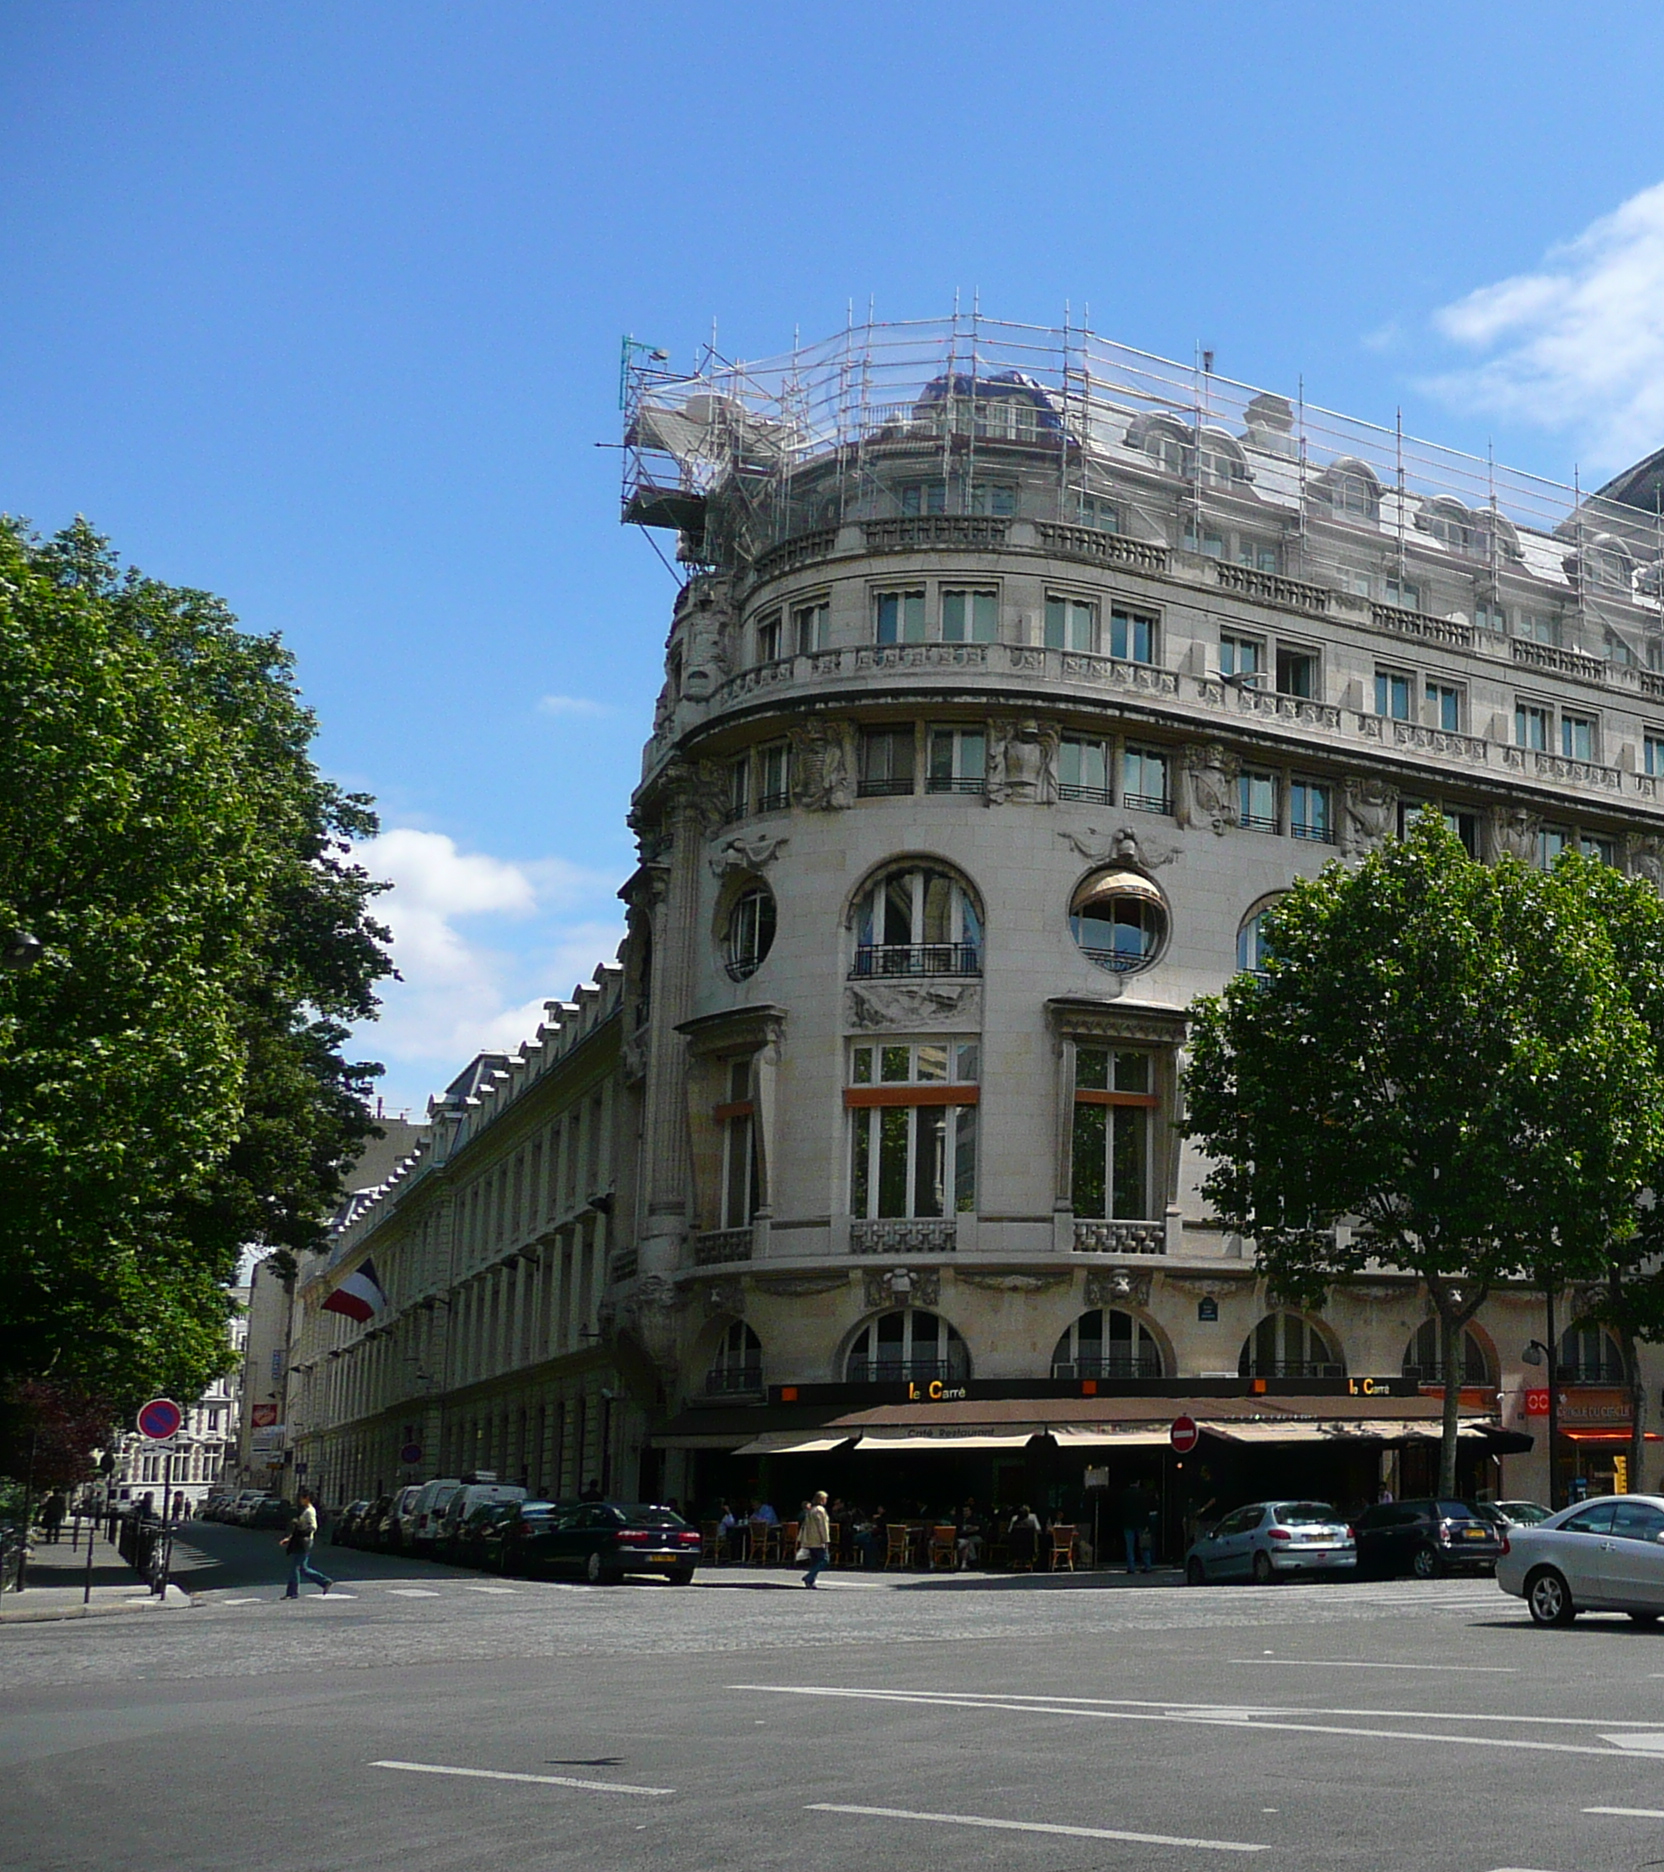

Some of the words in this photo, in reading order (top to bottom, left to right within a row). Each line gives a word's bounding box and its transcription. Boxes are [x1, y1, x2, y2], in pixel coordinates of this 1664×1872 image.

[909, 1382, 920, 1399] le
[929, 1381, 966, 1399] Carré
[907, 1428, 934, 1438] Café
[939, 1427, 995, 1438] Restaurant
